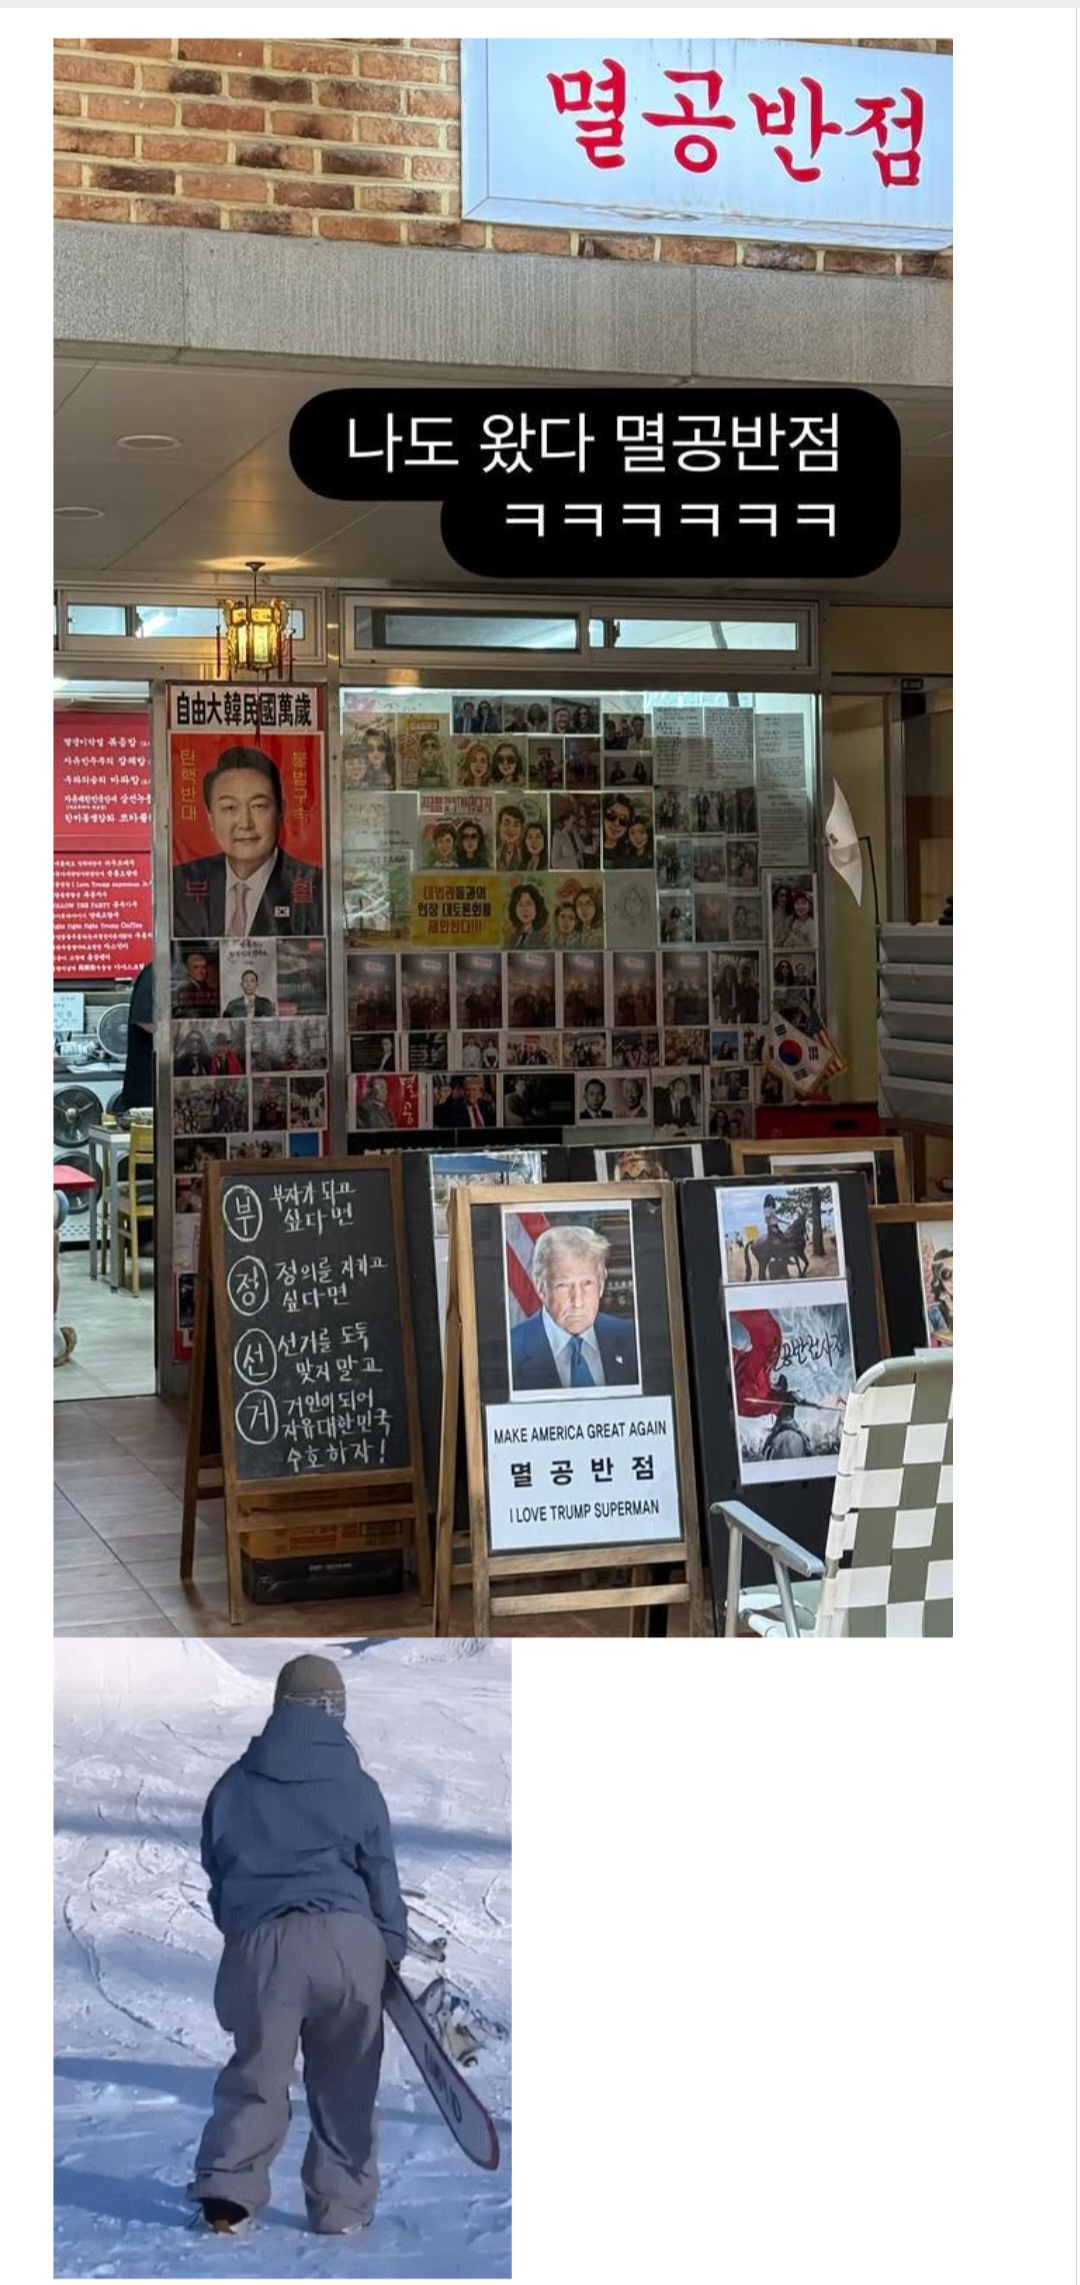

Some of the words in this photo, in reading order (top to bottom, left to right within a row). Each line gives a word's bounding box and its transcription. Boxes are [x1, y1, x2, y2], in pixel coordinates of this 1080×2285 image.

[547, 58, 923, 187] 멸공반점
[177, 690, 312, 726] 自由大韓民國萬歲
[181, 749, 197, 822] 탄핵반대
[270, 1181, 317, 1212] 부자가
[322, 1179, 357, 1206] 되고
[234, 1196, 256, 1235] 부
[283, 1201, 355, 1235] 싶다면
[236, 1265, 259, 1306] 정
[275, 1256, 332, 1286] 정의를
[341, 1253, 388, 1279] 지키고
[283, 1282, 352, 1313] 싶다면
[278, 1327, 332, 1357] 선거를
[341, 1321, 369, 1351] 도둑
[243, 1343, 268, 1376] 선
[296, 1357, 331, 1384] 맞지
[246, 1400, 269, 1432] 거
[281, 1408, 394, 1441] 자유대한민국
[494, 1427, 528, 1445] MAKE
[531, 1424, 584, 1442] AMERICA
[587, 1422, 626, 1439] GREAT
[629, 1420, 666, 1437] AGAIN
[509, 1508, 513, 1523] I
[516, 1506, 547, 1523] LOVE
[550, 1503, 591, 1520] TRUMP
[594, 1499, 659, 1518] SUPERMAN
